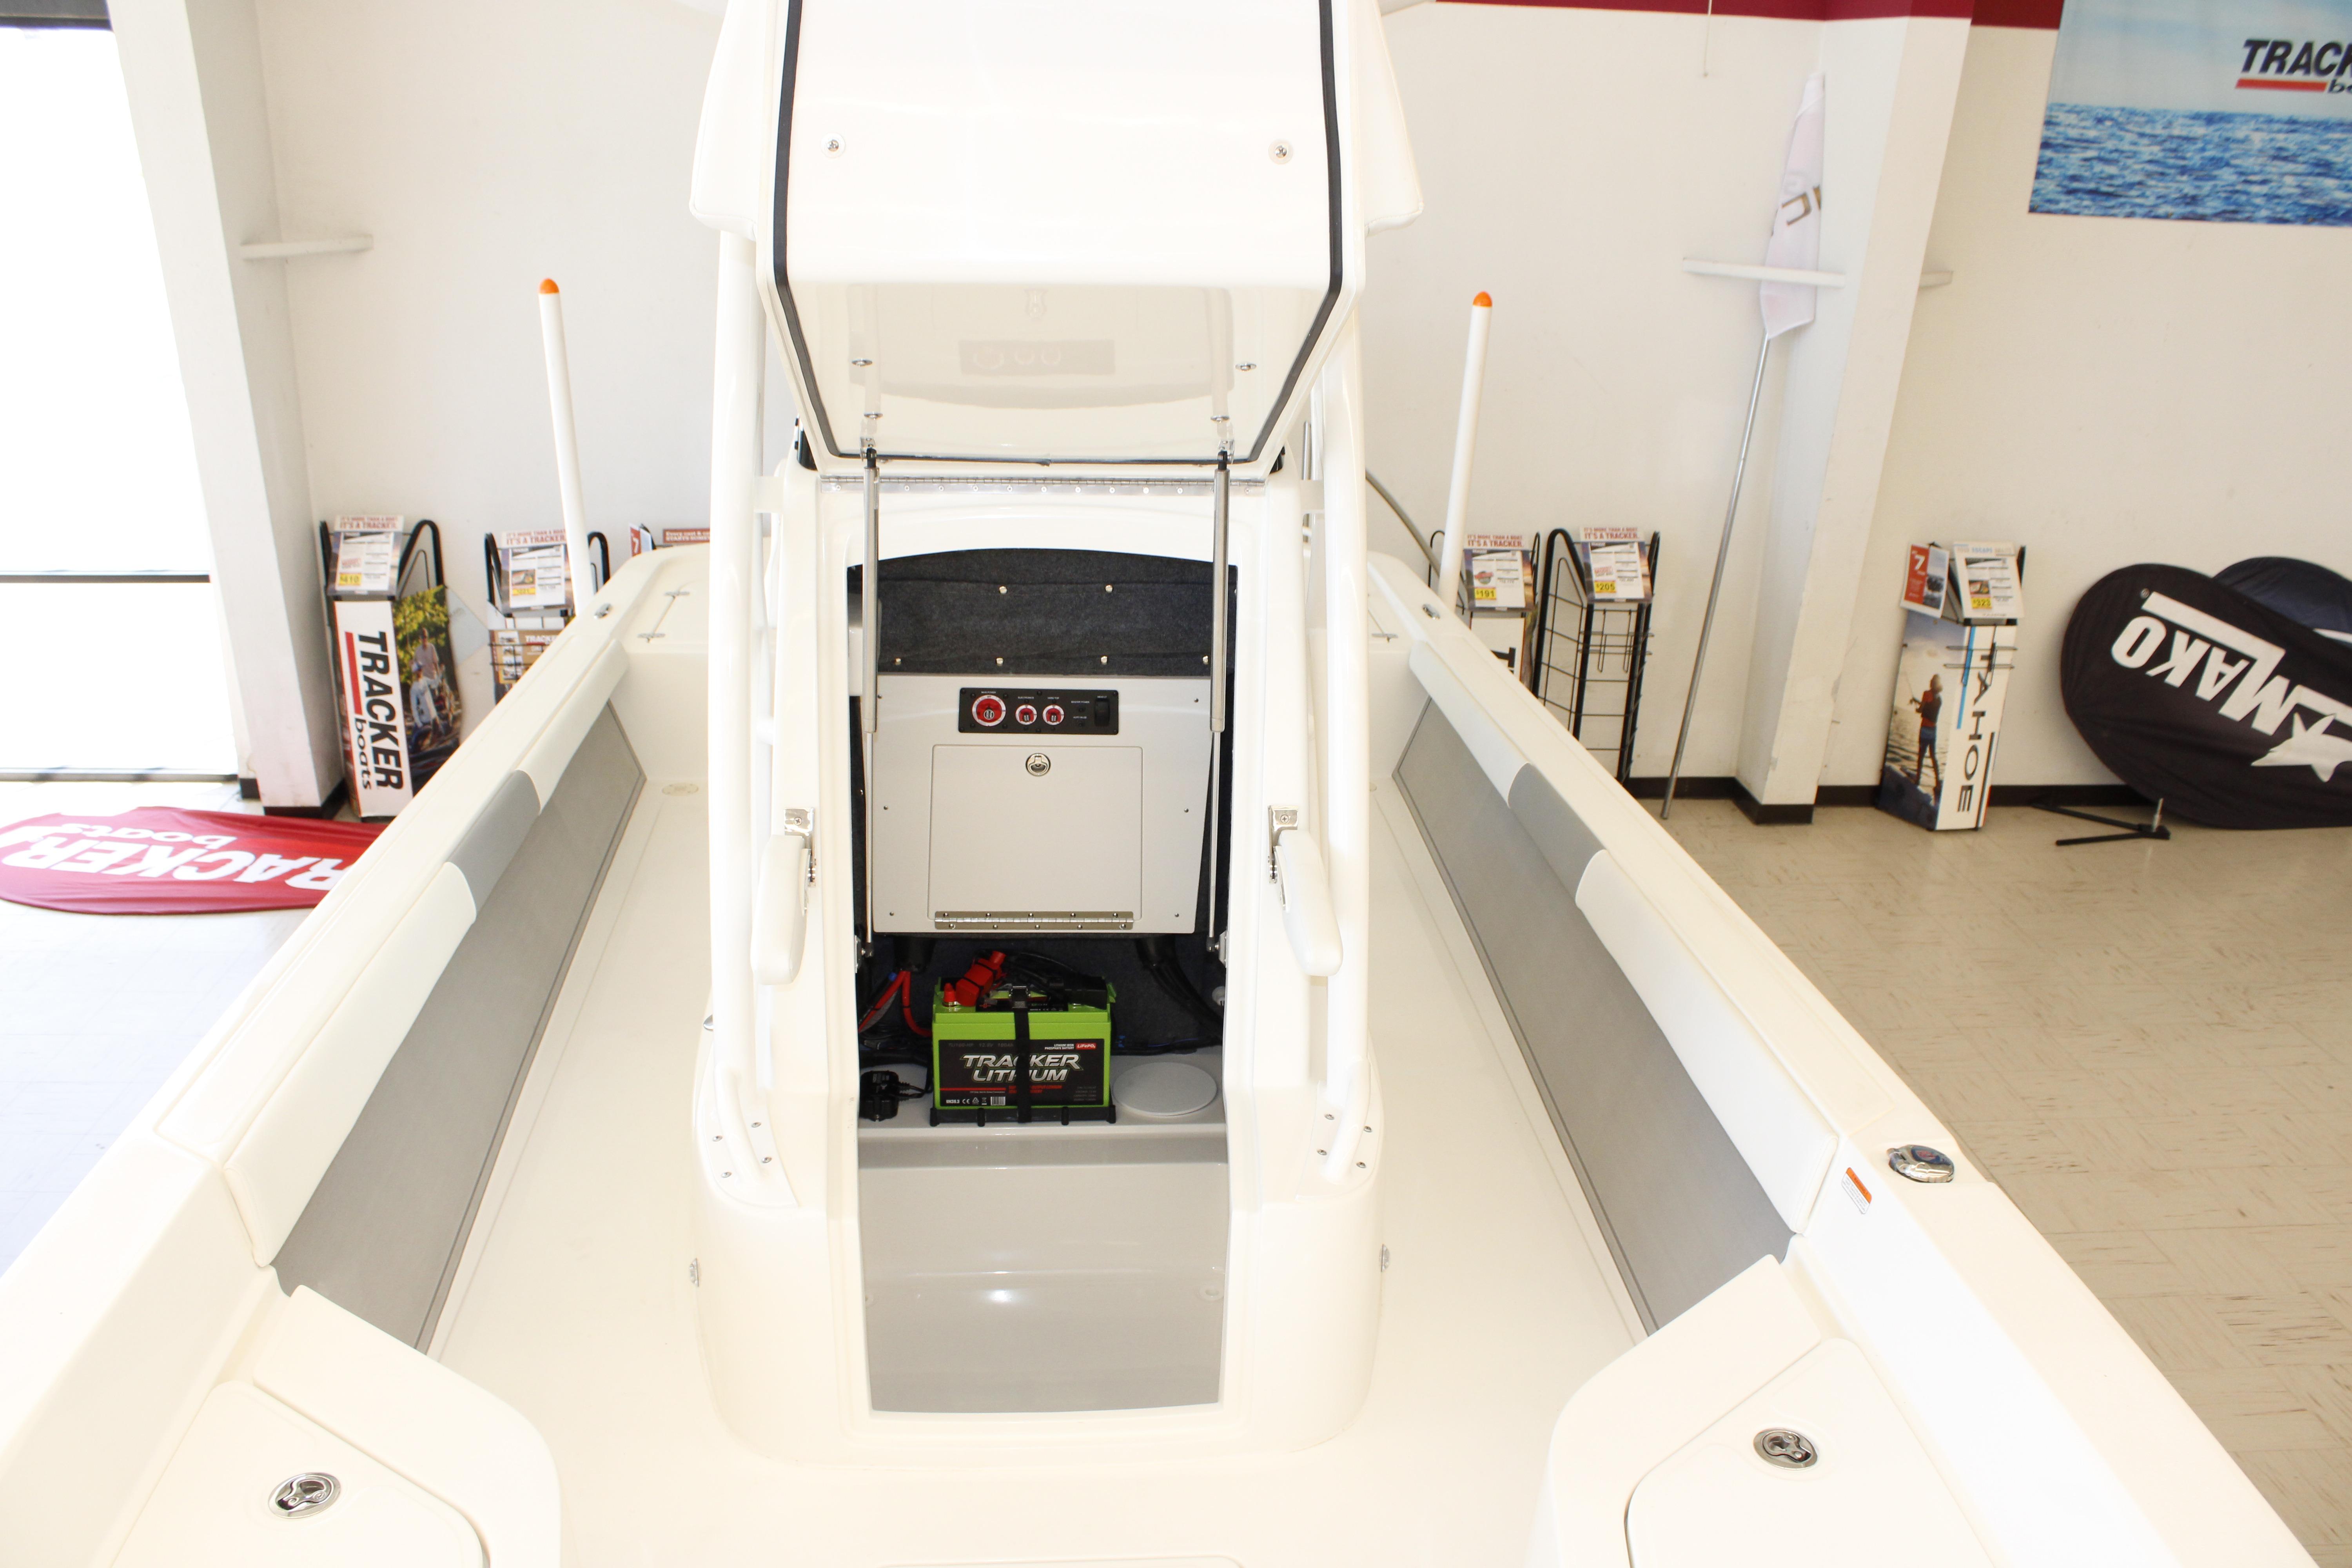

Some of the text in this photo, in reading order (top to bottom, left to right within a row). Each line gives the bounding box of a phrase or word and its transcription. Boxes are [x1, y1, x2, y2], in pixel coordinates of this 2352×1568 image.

[1915, 555, 1926, 570] 7
[2111, 615, 2301, 736] MAKO
[358, 631, 404, 789] TRACKER
[1957, 642, 1996, 812] TAHOE
[354, 717, 372, 790] boats
[61, 823, 237, 849] boats
[962, 1054, 1081, 1070] TRAKER
[973, 1069, 1068, 1082] LITUM
